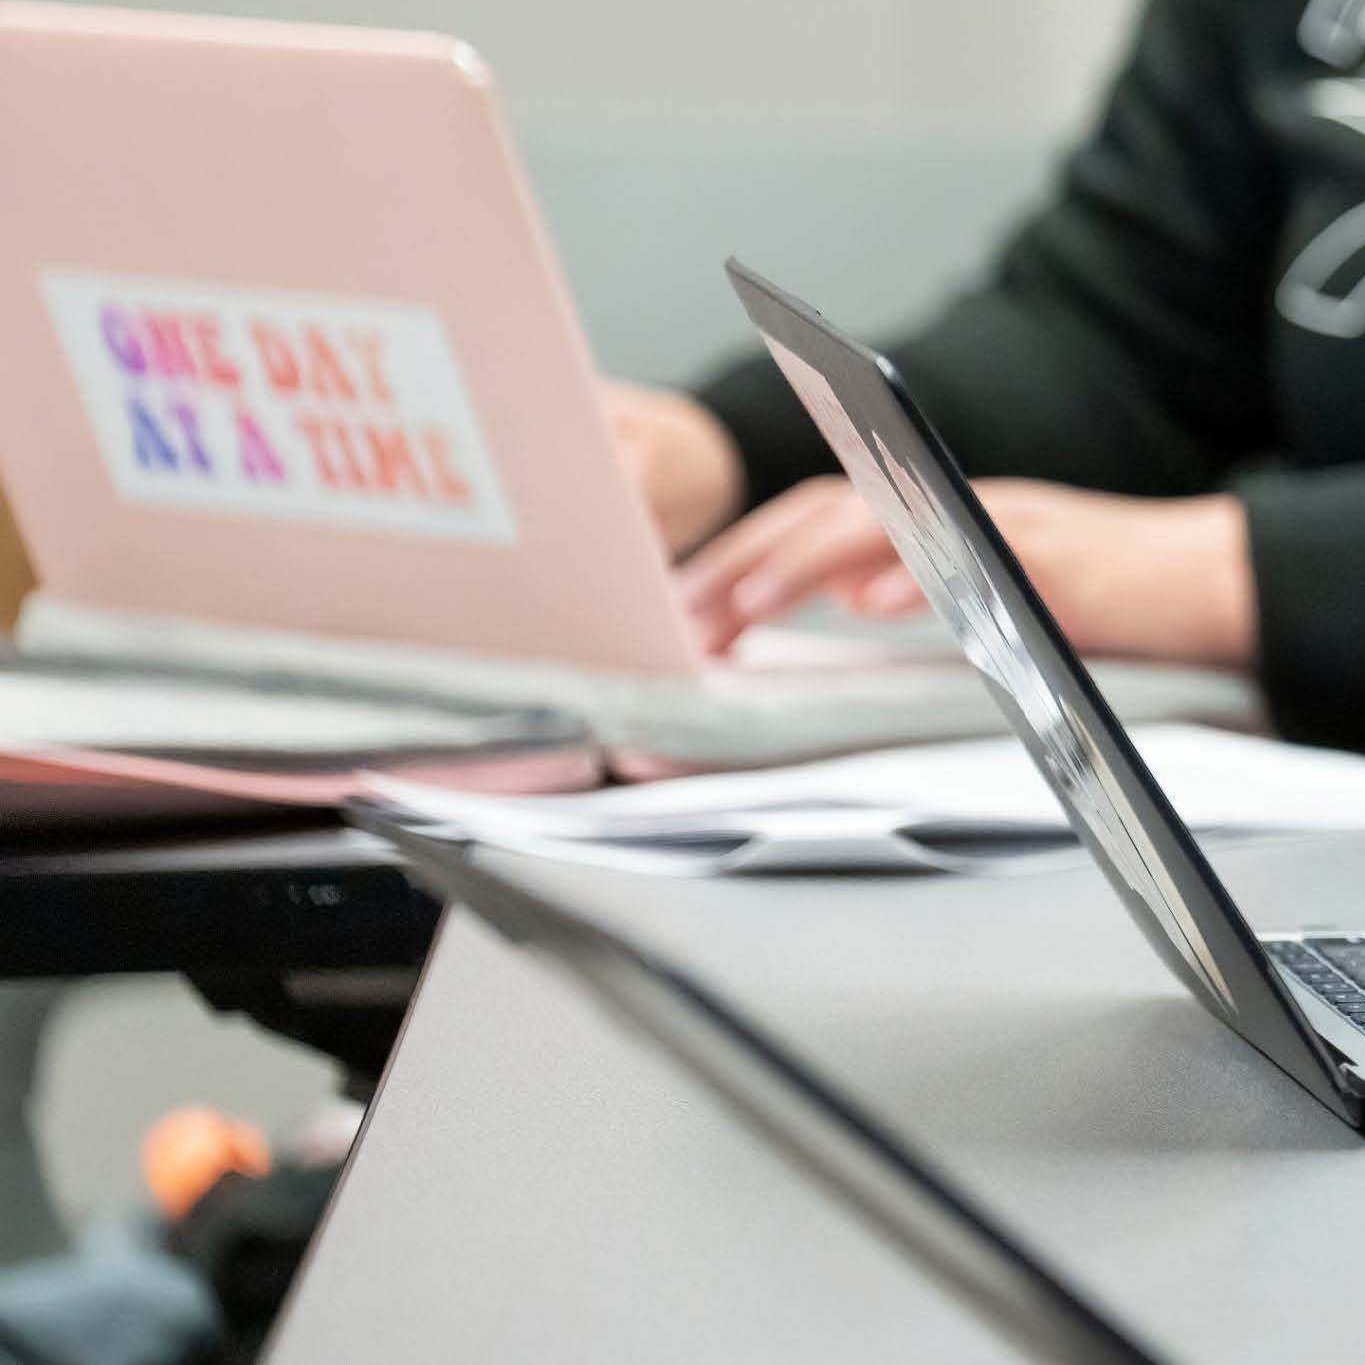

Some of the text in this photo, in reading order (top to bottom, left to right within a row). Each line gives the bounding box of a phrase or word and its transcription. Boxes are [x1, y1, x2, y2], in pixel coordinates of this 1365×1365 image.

[101, 303, 393, 405] ONE DAY
[128, 395, 473, 508] AT A TIME
